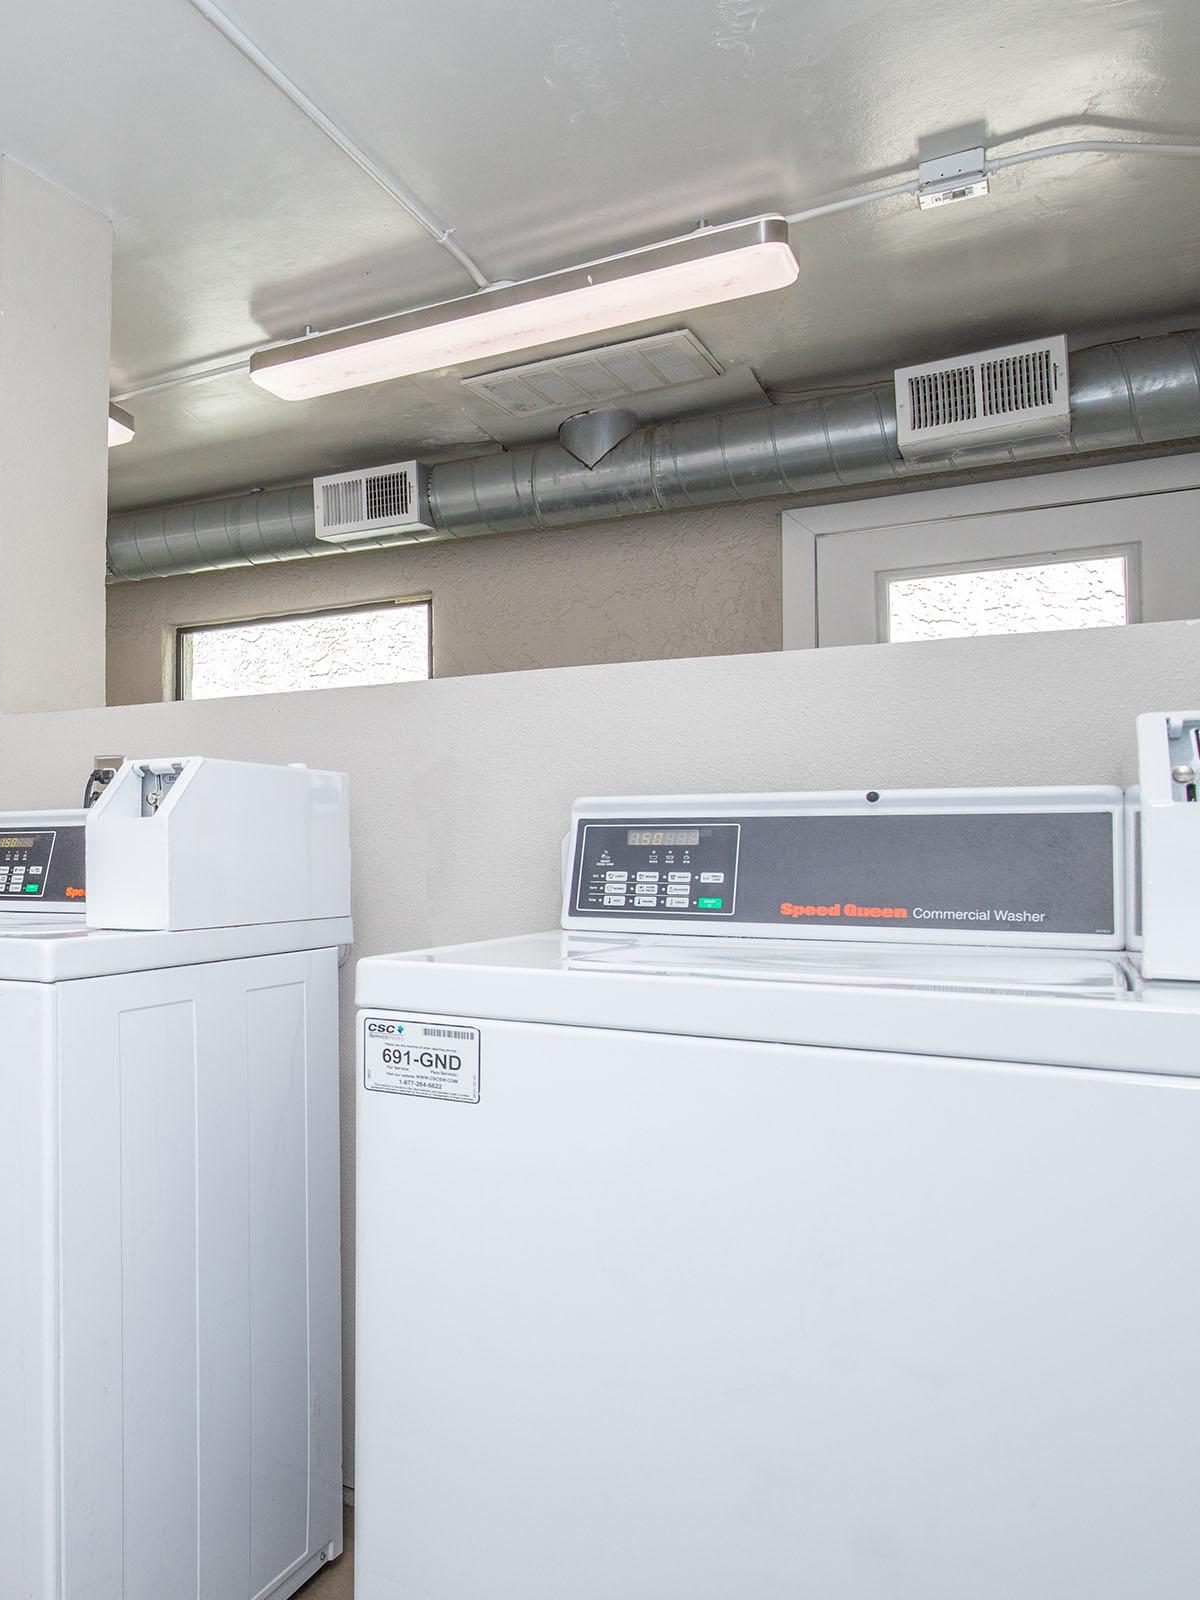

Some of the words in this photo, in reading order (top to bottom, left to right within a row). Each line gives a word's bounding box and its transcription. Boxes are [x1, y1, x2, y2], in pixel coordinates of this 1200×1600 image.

[780, 902, 841, 918] Speed
[843, 903, 908, 918] Queen
[912, 907, 991, 921] Commercial
[994, 909, 1046, 923] Washer
[368, 1023, 396, 1034] CSC
[382, 1048, 462, 1071] 691-GND
